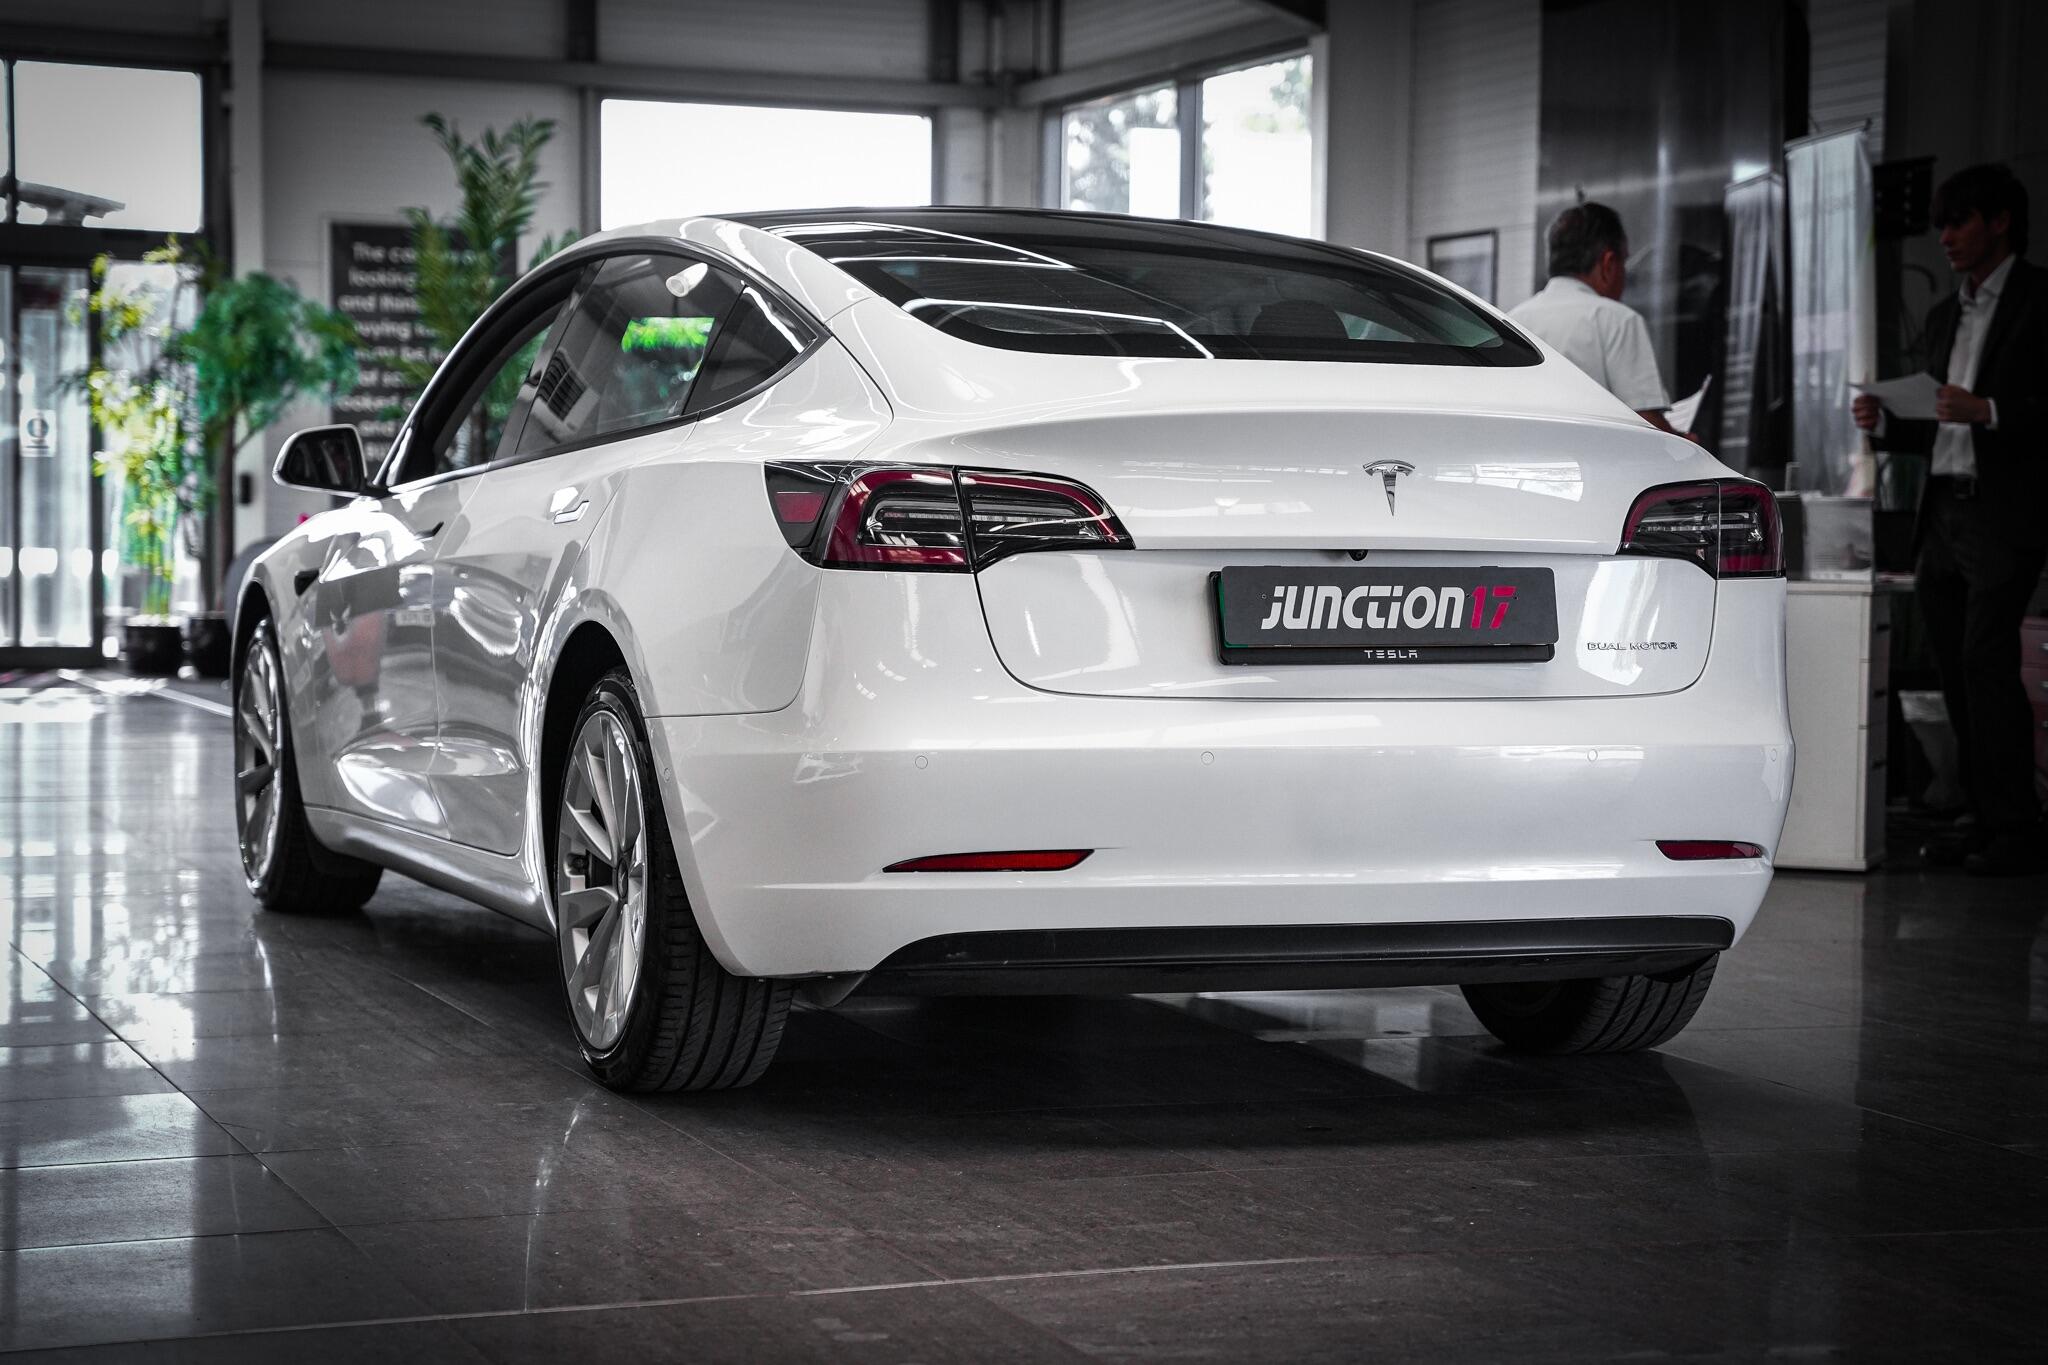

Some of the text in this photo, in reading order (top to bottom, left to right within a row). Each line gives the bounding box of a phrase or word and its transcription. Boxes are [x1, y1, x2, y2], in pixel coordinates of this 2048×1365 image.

[353, 243, 385, 262] The
[349, 267, 417, 291] looking
[339, 294, 376, 312] and
[1364, 649, 1418, 659] TESLA
[1587, 642, 1678, 650] DUAL MOTOR
